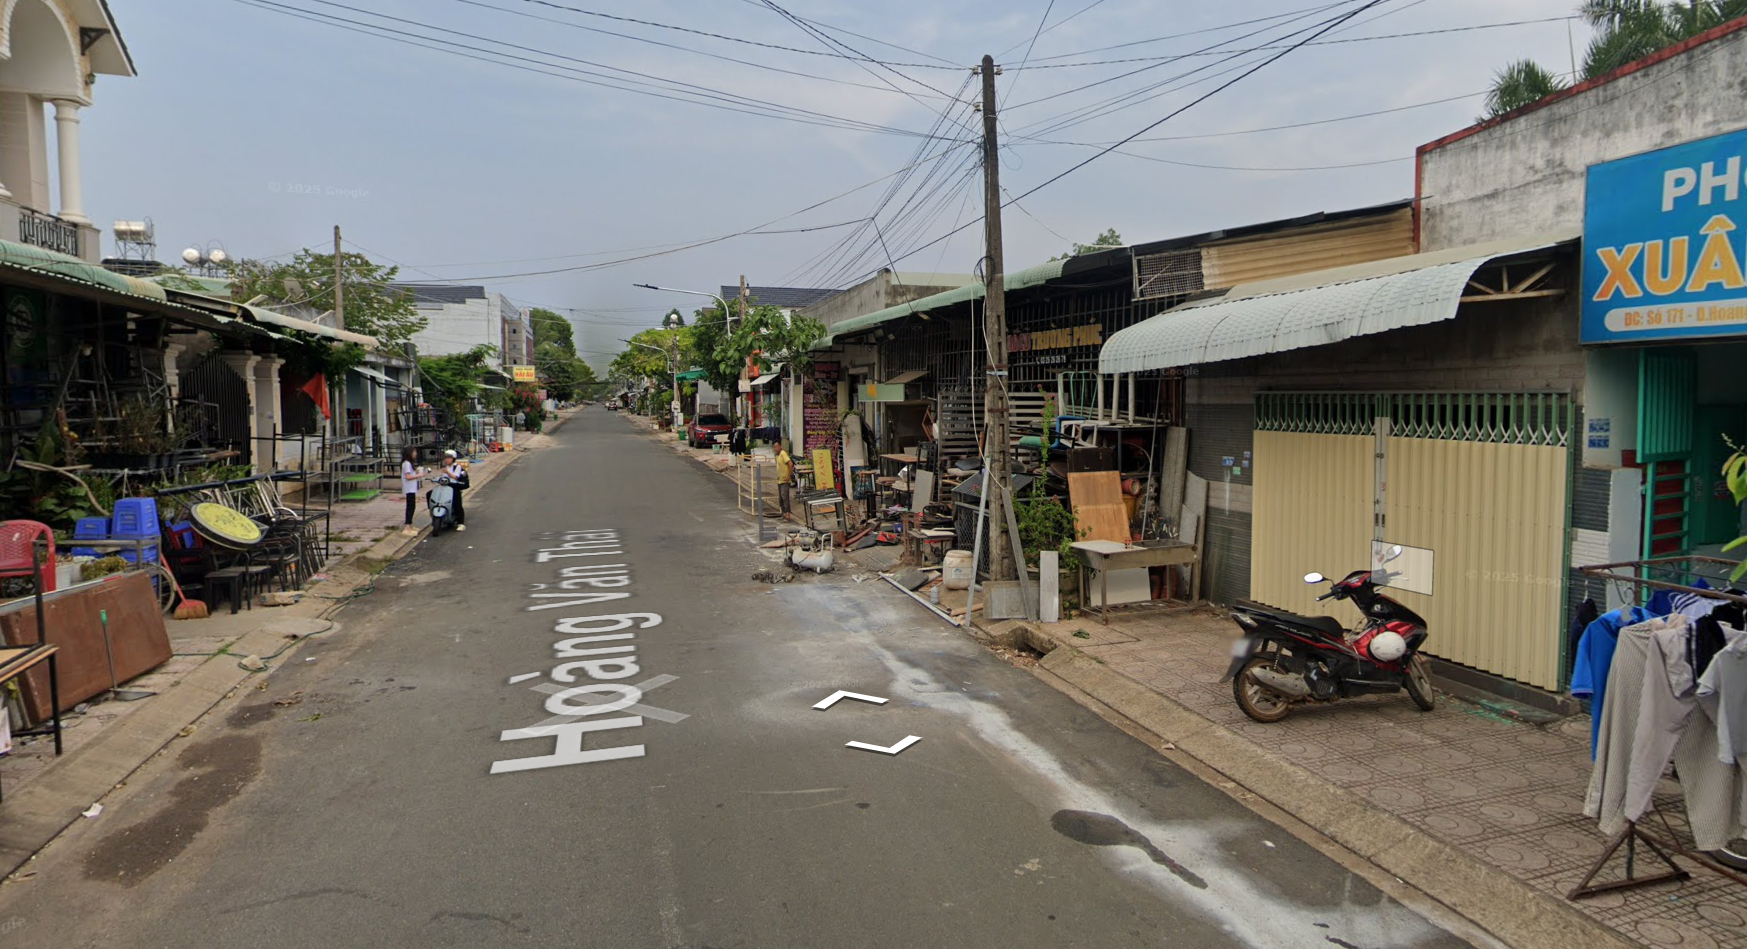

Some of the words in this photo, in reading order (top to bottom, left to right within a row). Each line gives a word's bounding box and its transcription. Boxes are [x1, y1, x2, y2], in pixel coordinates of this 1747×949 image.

[1661, 155, 1747, 212] PH
[1593, 214, 1747, 301] XUÂ
[1667, 307, 1685, 323] 171
